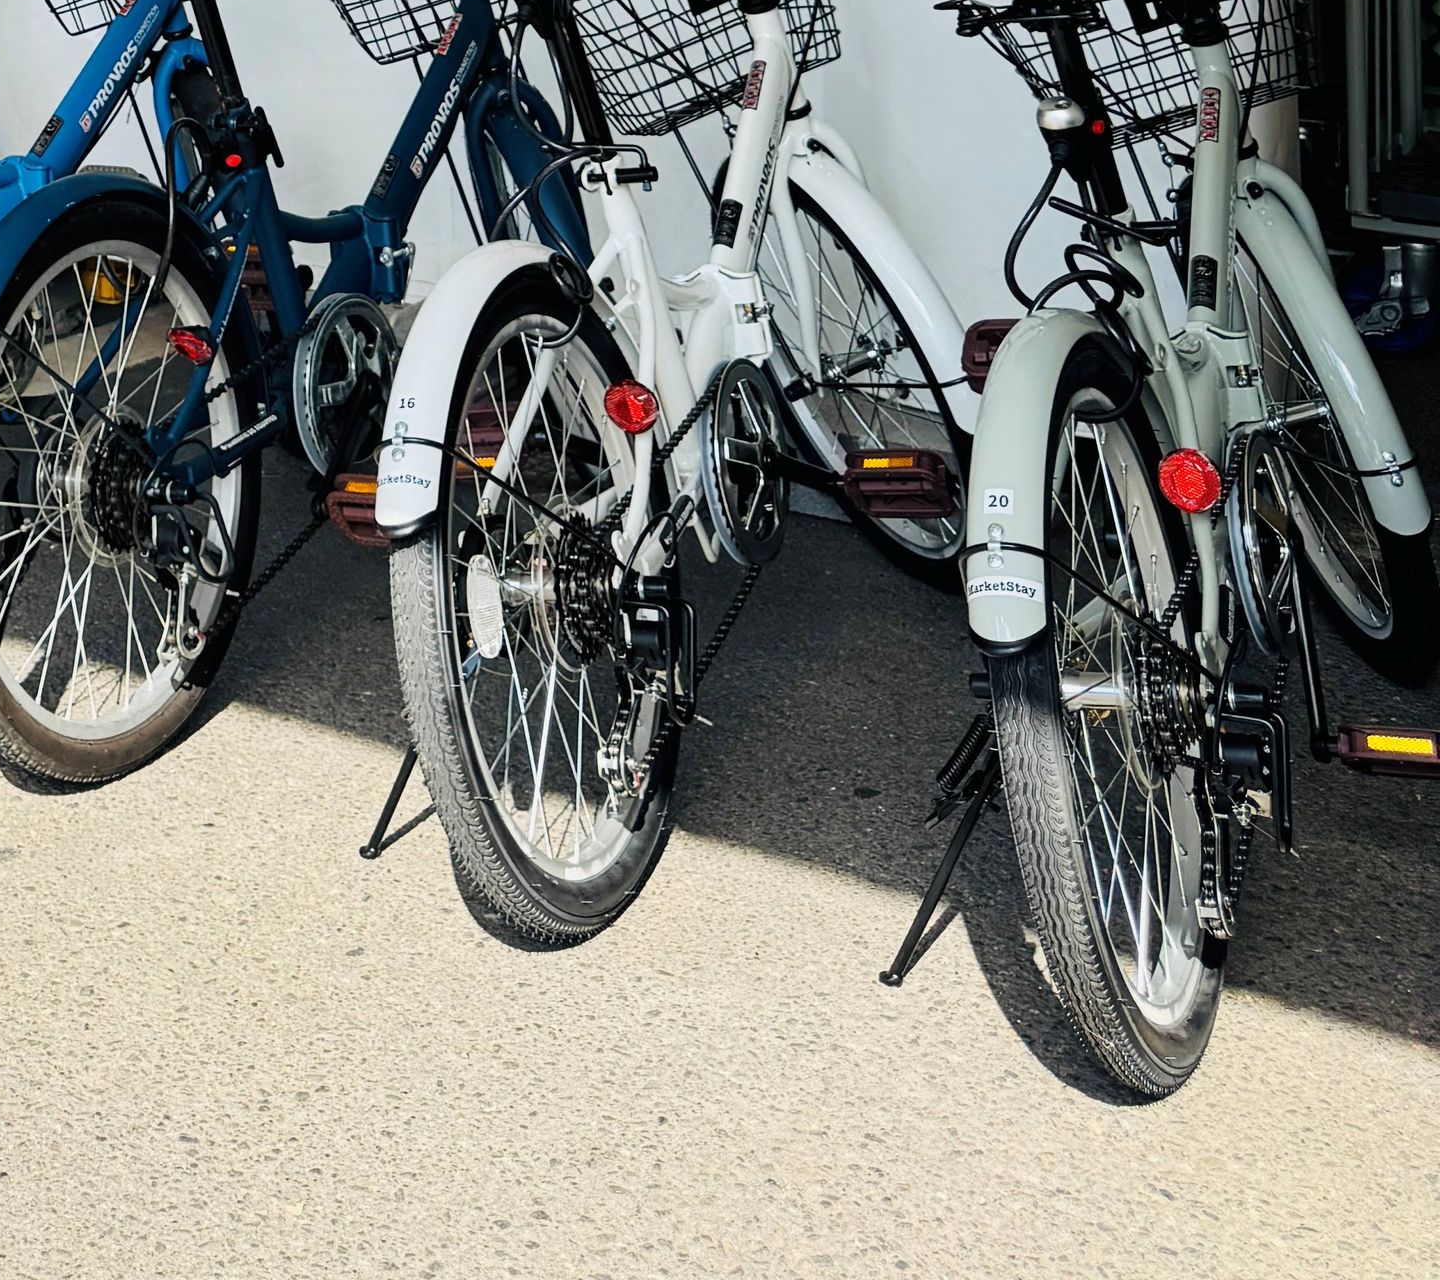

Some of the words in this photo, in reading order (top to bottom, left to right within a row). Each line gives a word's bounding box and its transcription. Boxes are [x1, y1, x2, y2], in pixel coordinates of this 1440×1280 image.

[88, 40, 139, 119] PROVROS
[134, 5, 159, 40] CONNECTION
[417, 78, 460, 162] PROVROS
[399, 397, 416, 409] 16
[988, 494, 1009, 508] 20
